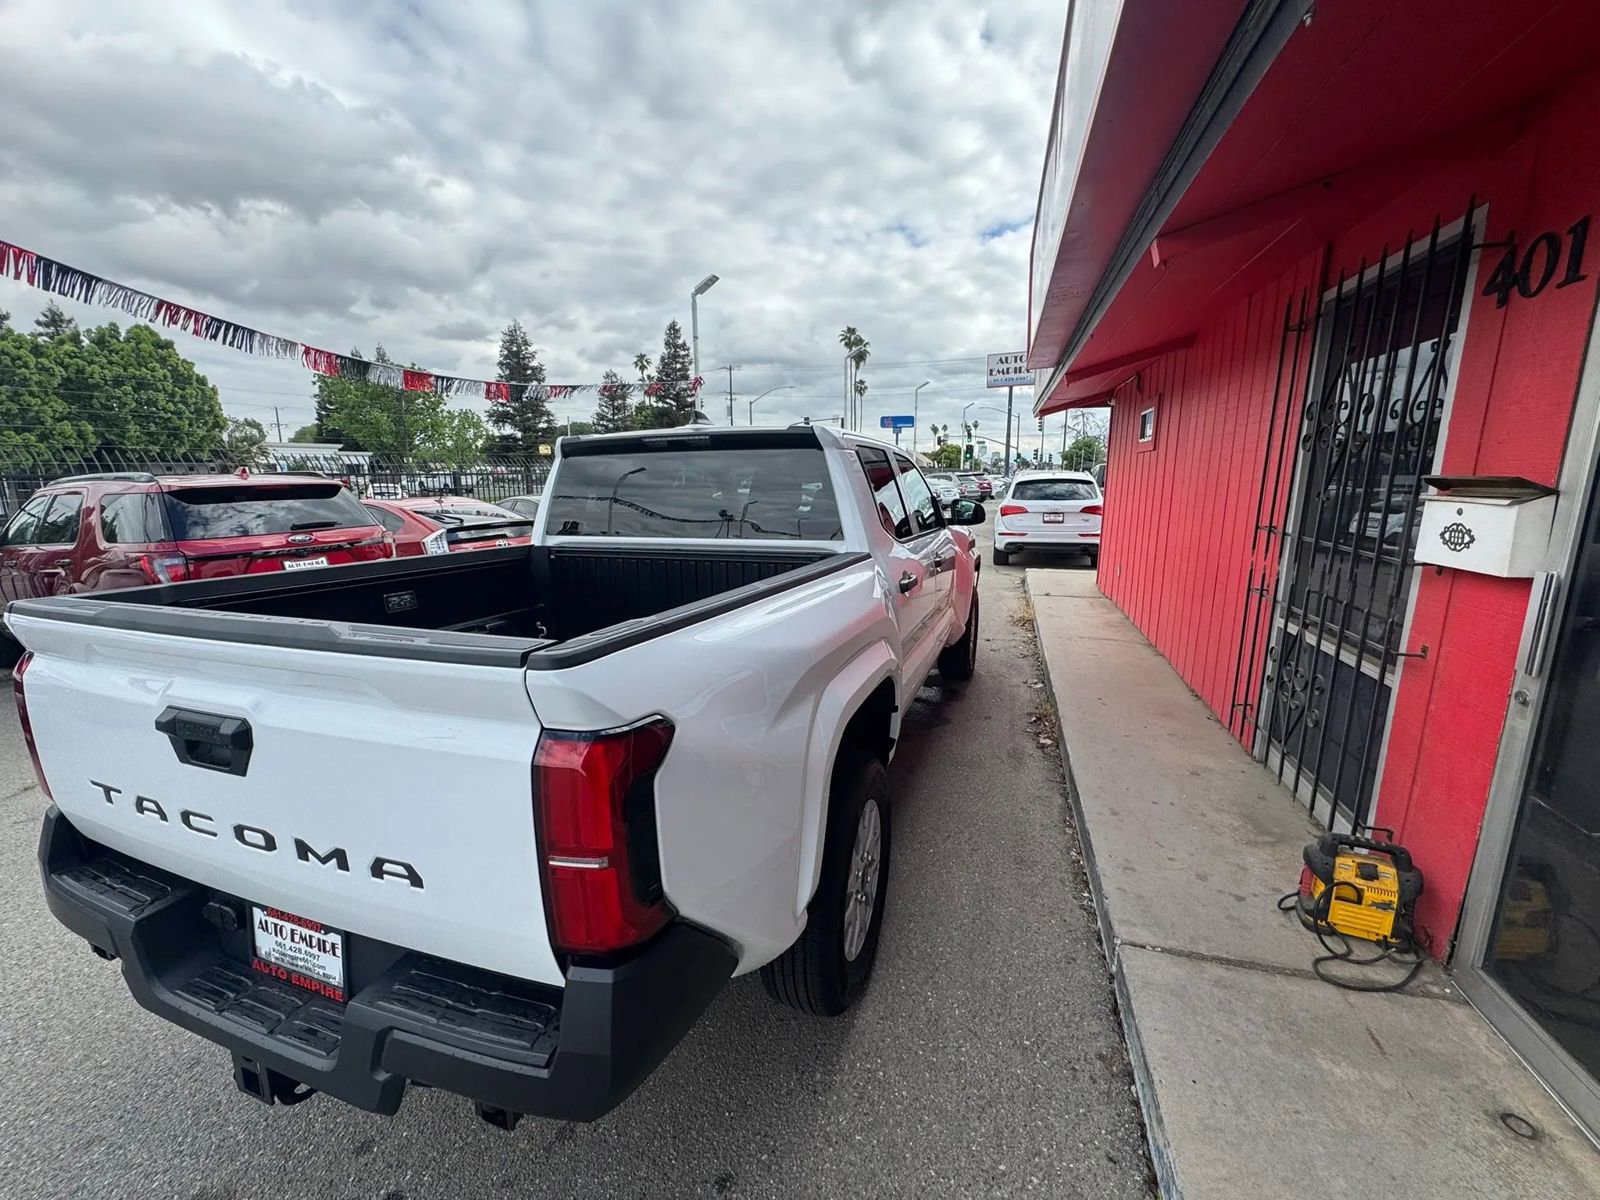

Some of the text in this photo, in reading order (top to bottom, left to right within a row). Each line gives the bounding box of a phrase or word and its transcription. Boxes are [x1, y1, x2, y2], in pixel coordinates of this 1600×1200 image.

[1482, 215, 1592, 309] 401
[989, 366, 1034, 376] EMPIRE
[996, 354, 1027, 365] AUTO
[90, 779, 425, 889] TACOMA
[258, 917, 340, 958] AUTO EMPIRE
[252, 960, 344, 1002] AUTO EMPIRE
